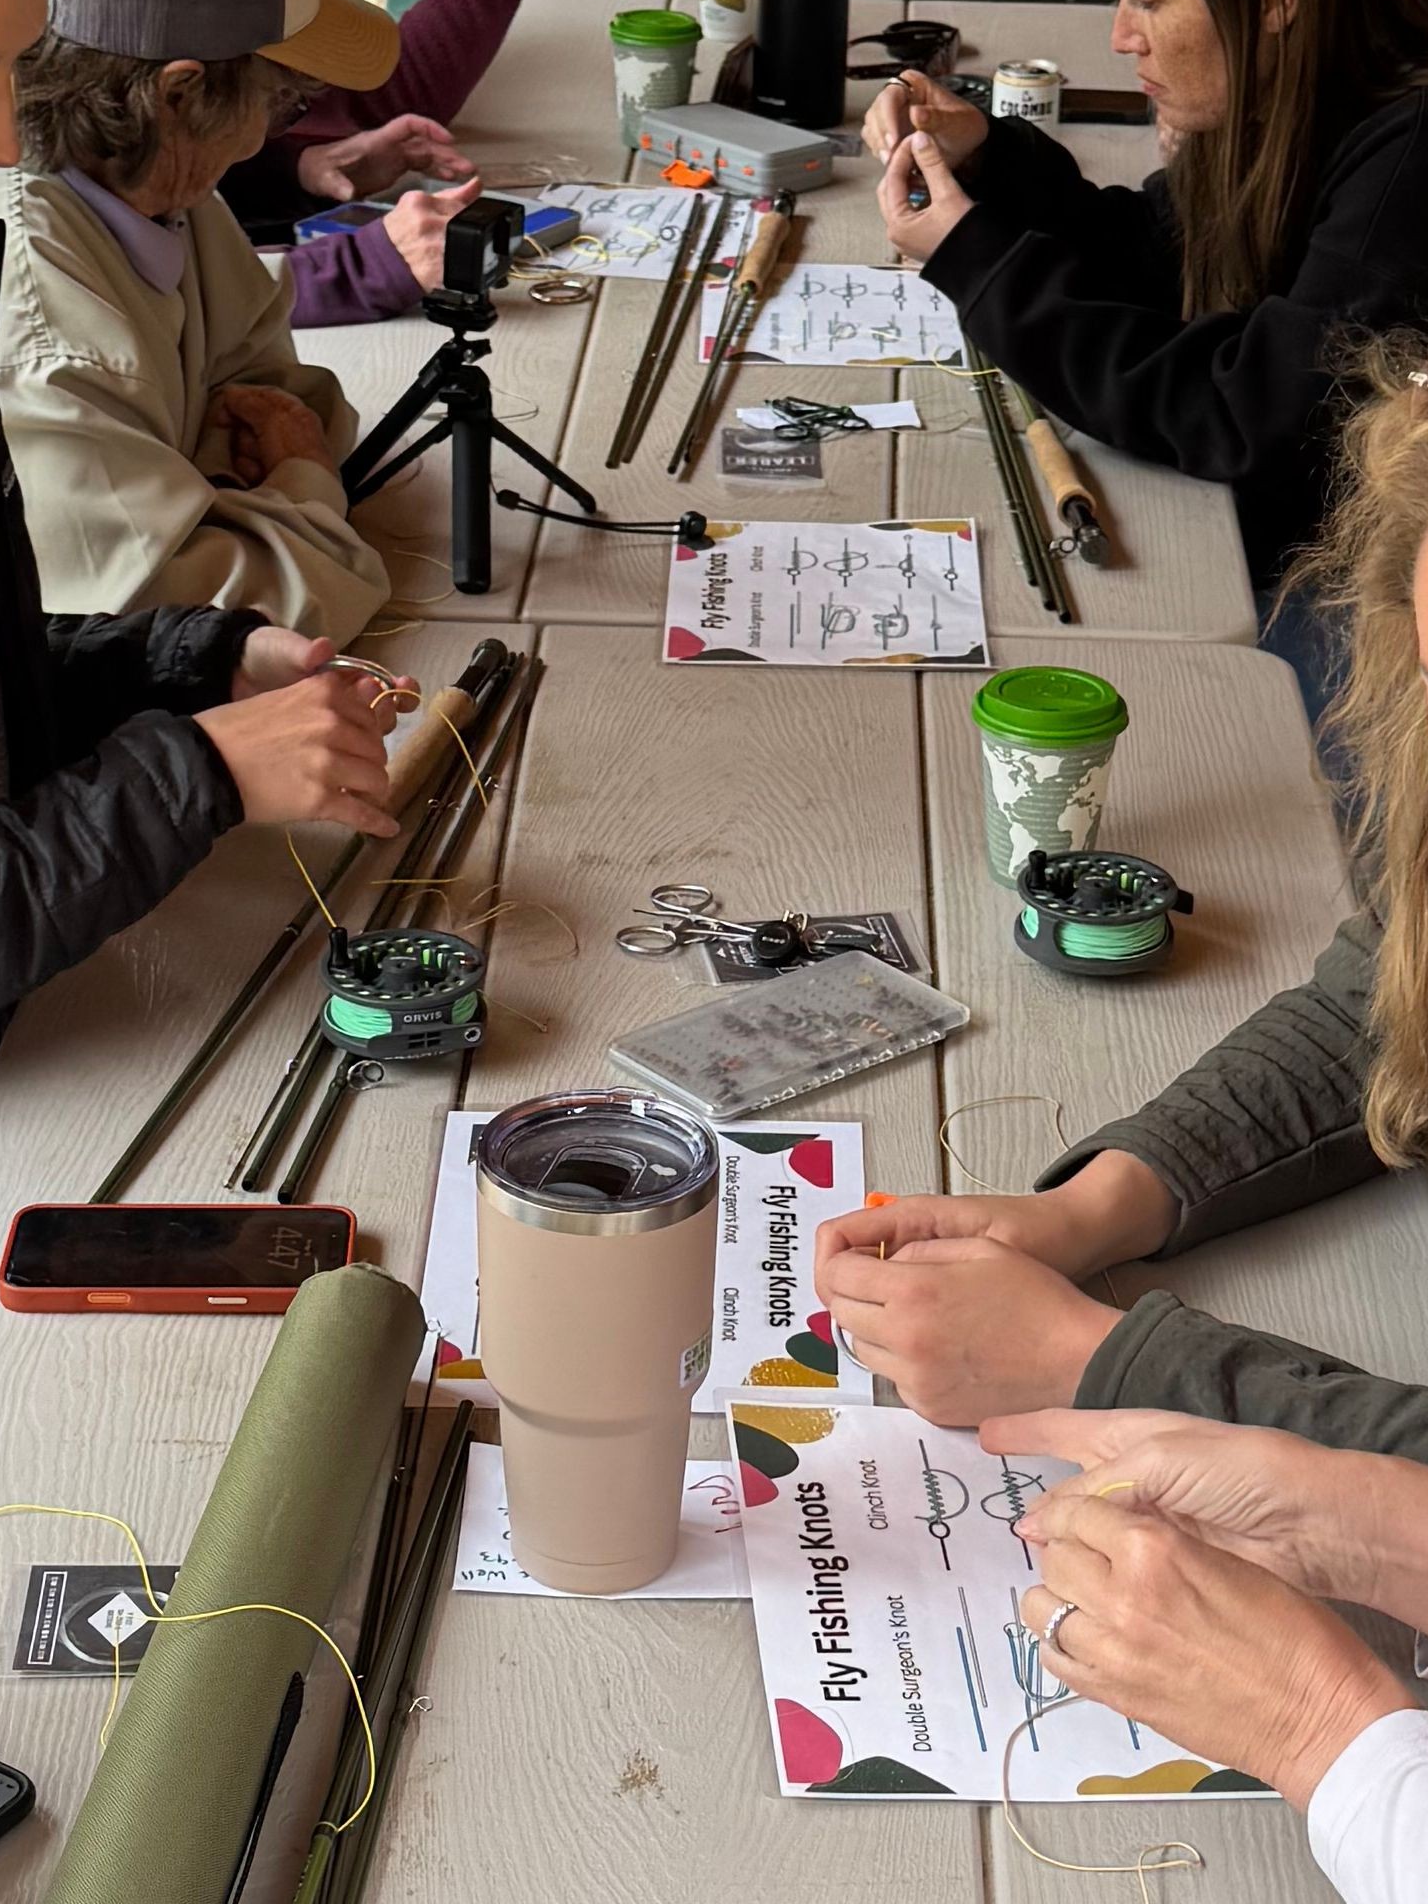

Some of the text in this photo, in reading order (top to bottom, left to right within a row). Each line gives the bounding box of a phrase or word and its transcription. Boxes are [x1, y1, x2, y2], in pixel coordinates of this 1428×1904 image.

[700, 612, 732, 629] Fly
[403, 1010, 442, 1024] ORVIS
[761, 1185, 799, 1328] Fly Fishing Knots
[722, 1287, 740, 1341] Clinch Knot
[858, 1459, 889, 1531] Clinch Knot
[797, 1481, 868, 1702] Fly Fishing Knots
[886, 1594, 933, 1753] Double Surgeon's Knot
